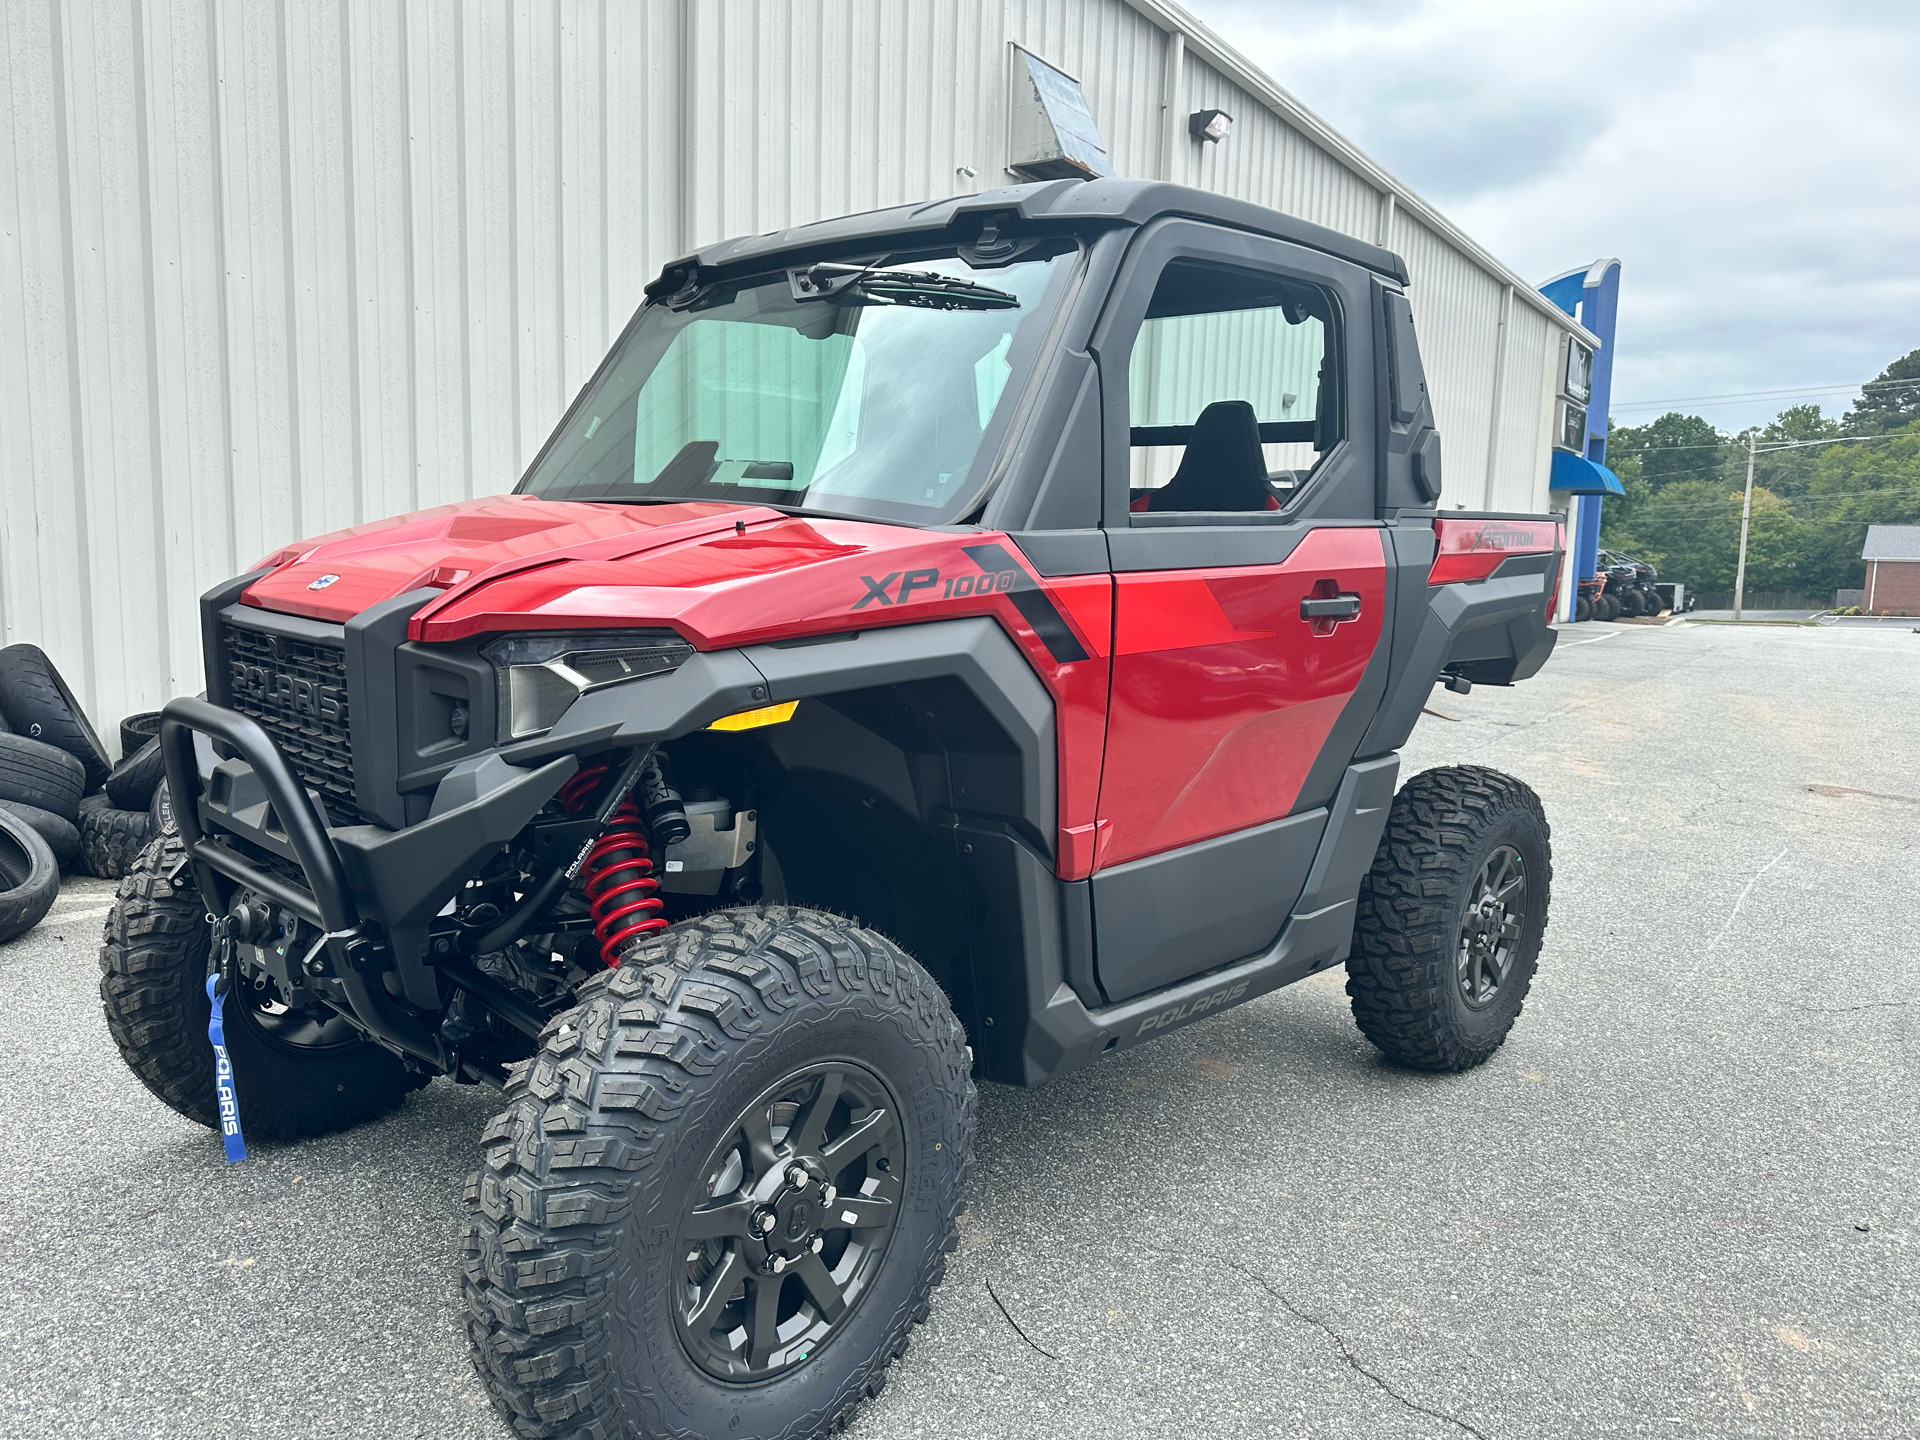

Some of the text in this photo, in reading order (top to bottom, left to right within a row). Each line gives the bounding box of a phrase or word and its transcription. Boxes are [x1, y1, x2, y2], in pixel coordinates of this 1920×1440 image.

[1470, 524, 1534, 552] XPEDITION
[850, 568, 1017, 610] XP 1000
[232, 661, 344, 722] POLARIS
[565, 838, 594, 878] POLARIS
[1135, 980, 1251, 1037] POLARIS
[213, 1044, 238, 1136] POLARIS
